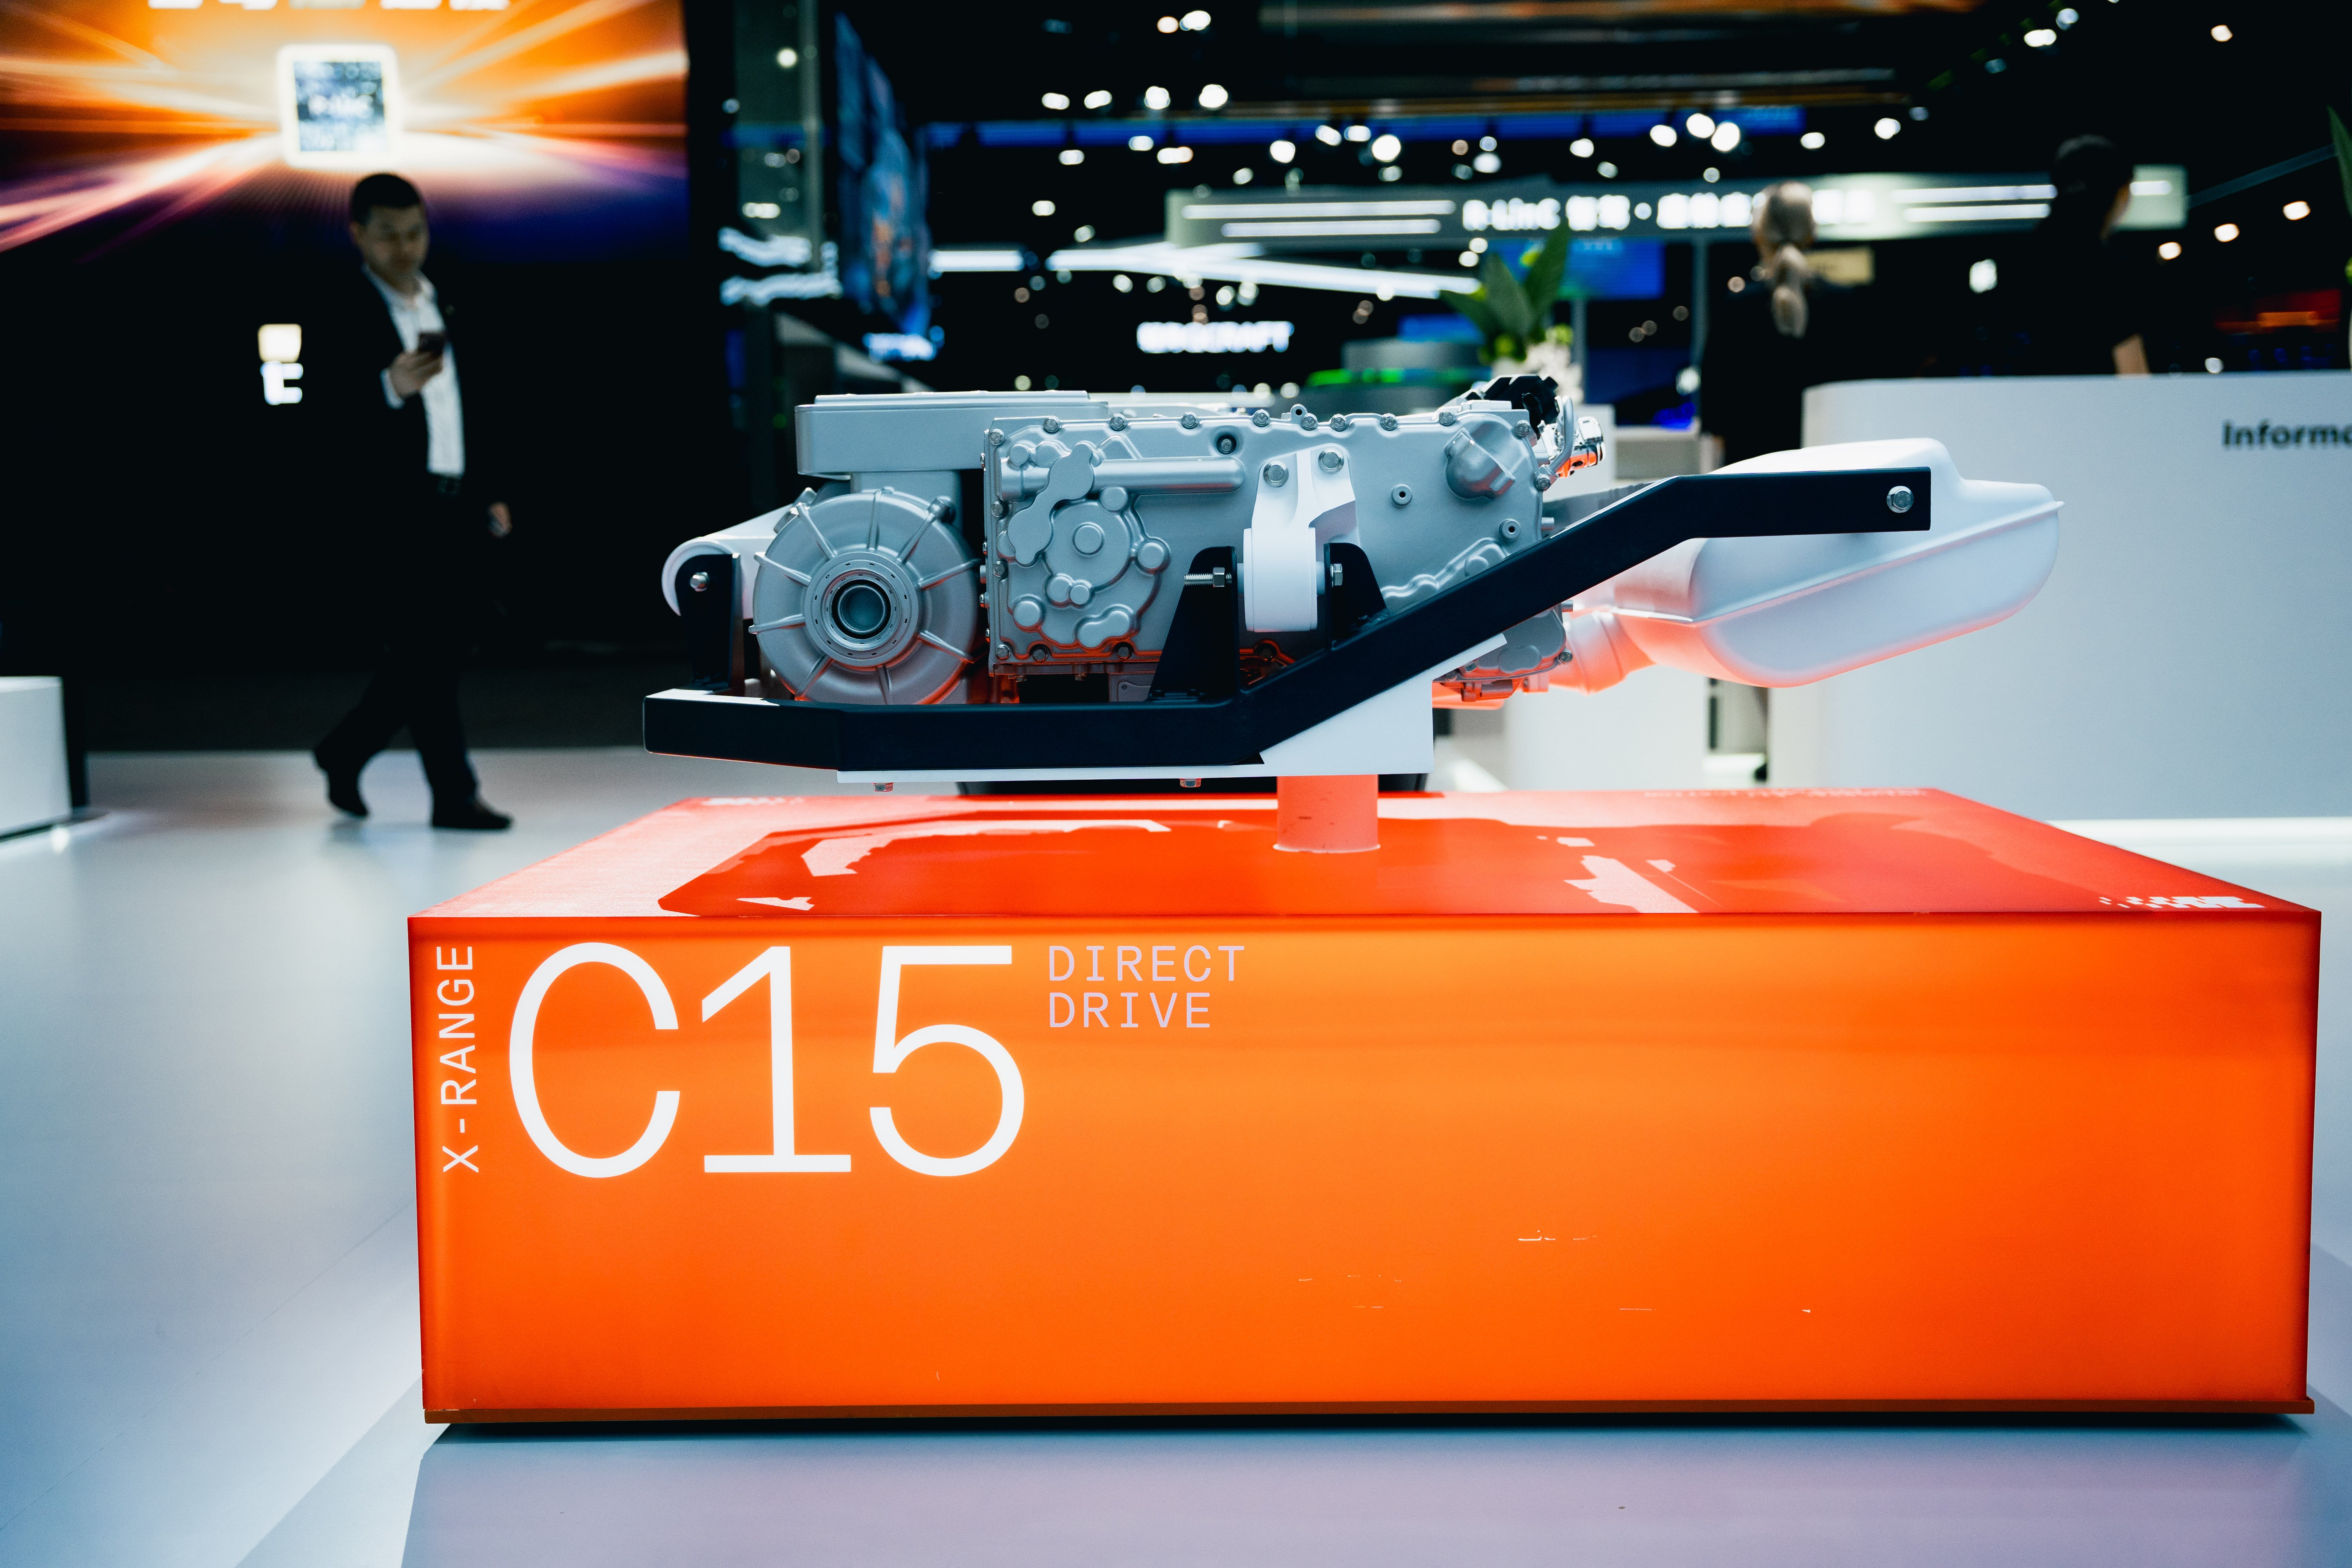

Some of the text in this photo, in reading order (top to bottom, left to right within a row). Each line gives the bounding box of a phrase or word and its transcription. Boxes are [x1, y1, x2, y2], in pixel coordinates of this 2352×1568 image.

[1049, 945, 1244, 982] DIRECT
[1050, 993, 1210, 1027] DRIVE
[437, 947, 478, 1172] X-RANGE
[510, 942, 1024, 1178] C15
